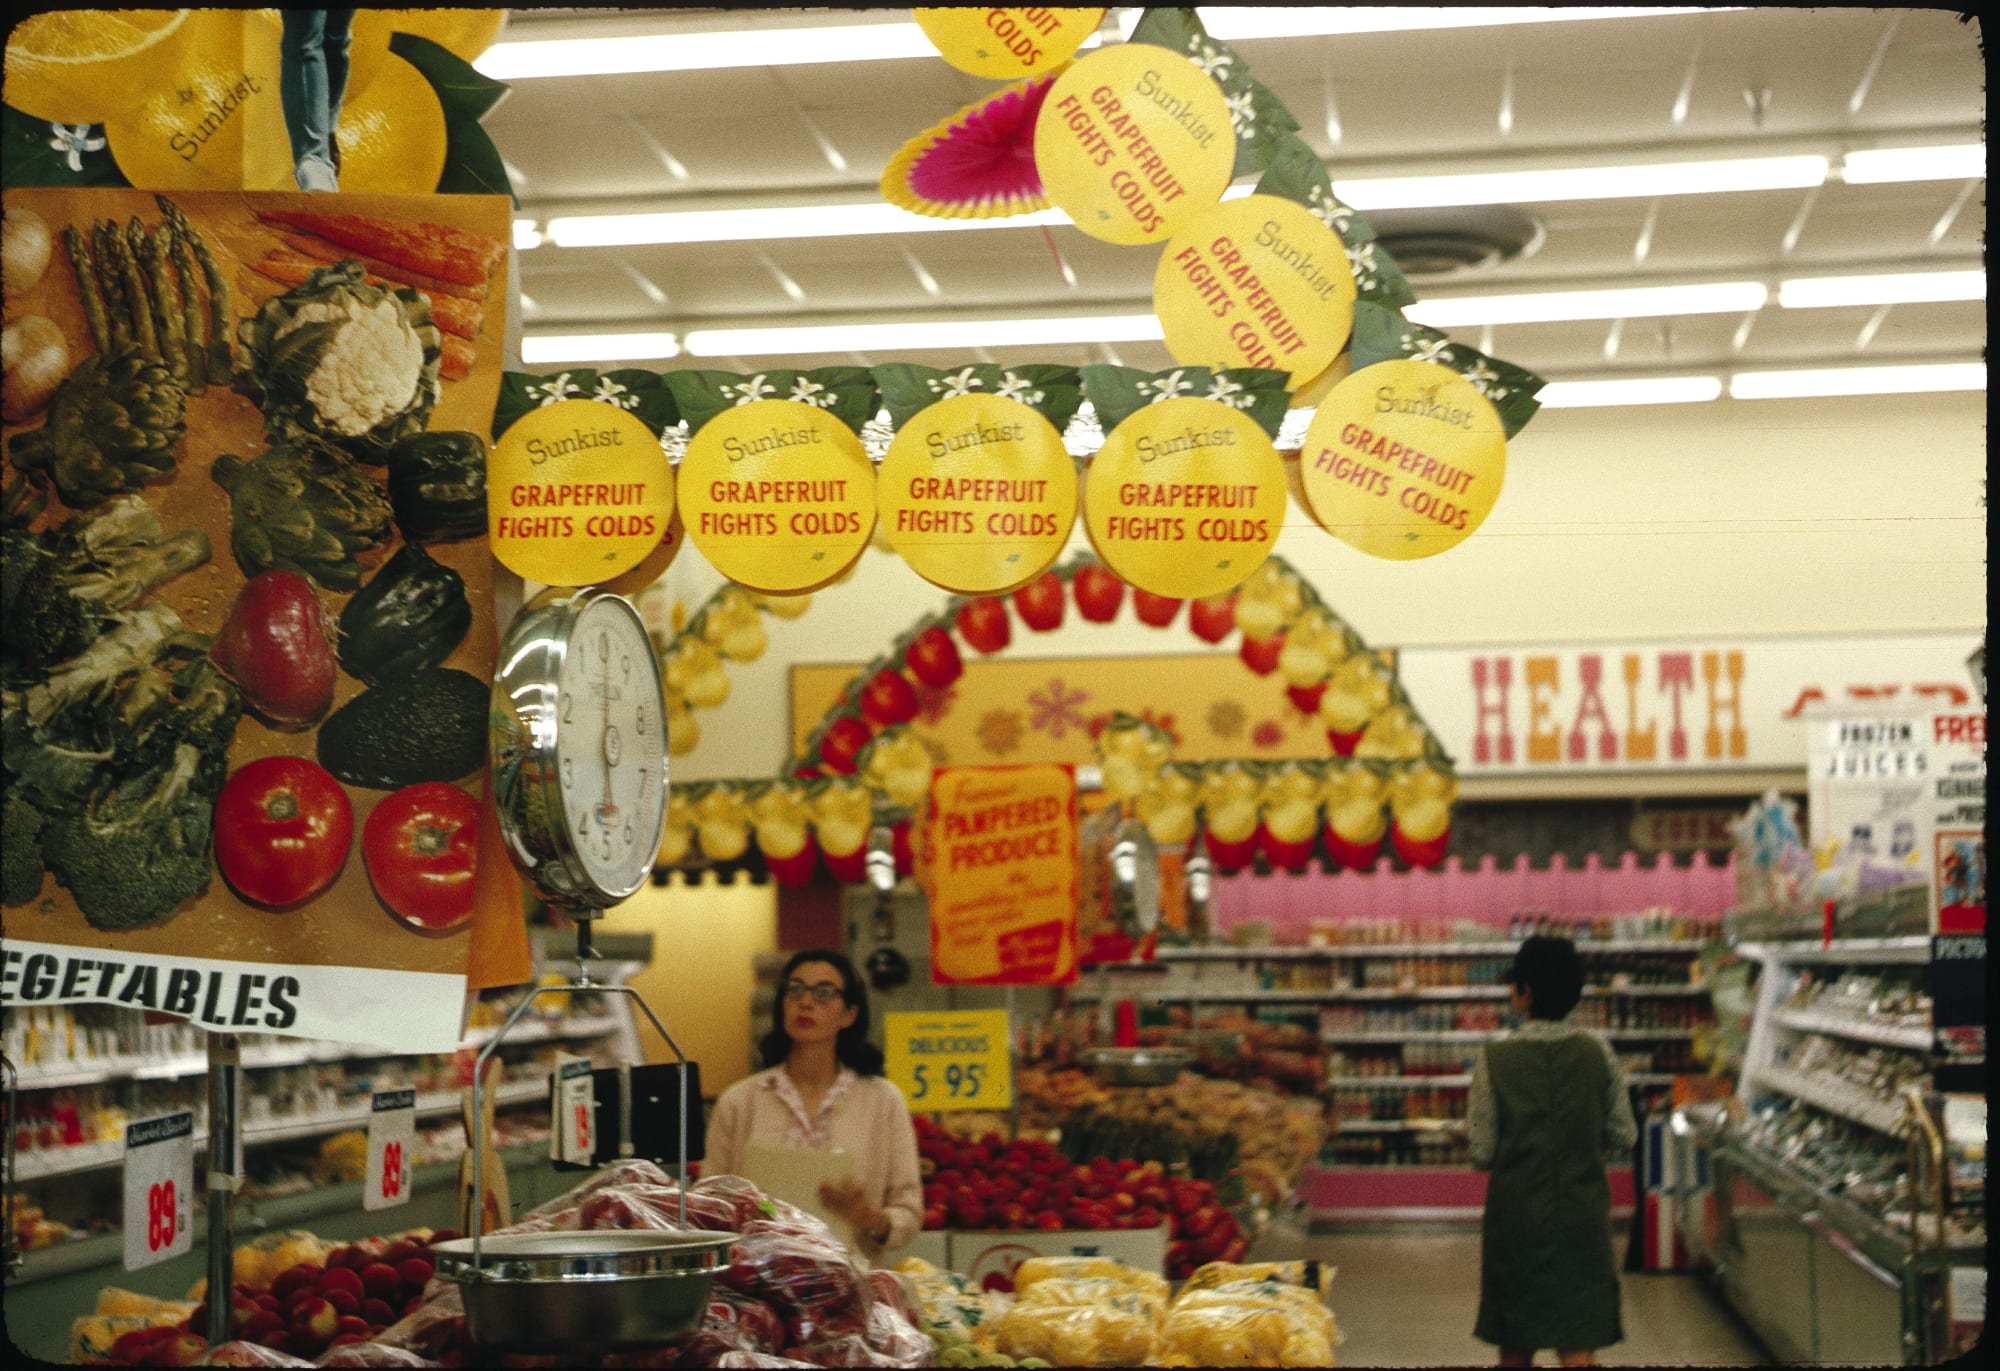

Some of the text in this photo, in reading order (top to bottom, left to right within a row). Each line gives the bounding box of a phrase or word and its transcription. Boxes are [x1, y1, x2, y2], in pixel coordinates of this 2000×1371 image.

[986, 8, 1043, 66] COLDS
[169, 74, 262, 162] Sunkist
[1136, 69, 1216, 150] Sunkist
[1091, 85, 1185, 203] GRAPEFRUIT
[1056, 94, 1165, 234] FIGHTS COLDS
[1255, 219, 1337, 301] Sunkist
[1174, 246, 1284, 370] FIGHTS COLD
[1210, 236, 1307, 355] GRAPEFRUIT
[1374, 385, 1475, 430] Sunkist
[526, 427, 624, 466] Sunkist
[723, 426, 822, 463] Sunkist
[926, 421, 1024, 460] Sunkist
[1135, 425, 1236, 464] Sunkist
[1341, 423, 1476, 495] GRAPEFRUIT
[511, 483, 646, 507] GRAPEFRUIT
[710, 480, 847, 503] GRAPEFRUIT
[910, 477, 1047, 502] GRAPEFRUIT
[1120, 483, 1258, 508] GRAPEFRUIT
[1313, 448, 1471, 531] FIGHTS COLDS
[498, 516, 573, 538] FIGHTS
[586, 515, 655, 537] COLDS
[700, 512, 776, 536] FIGHTS
[790, 512, 860, 535] COLDS
[897, 509, 1057, 536] FIGHTS COLDS
[1107, 516, 1269, 543] FIGHTS COLDS
[563, 693, 573, 724] 2
[1470, 649, 1747, 763] HEALTH
[563, 758, 573, 789] 3
[638, 768, 648, 793] 7
[1, 950, 300, 1029] EGETABLES
[912, 1064, 928, 1099] 5
[381, 1141, 402, 1199] 89
[148, 1179, 176, 1252] 89
